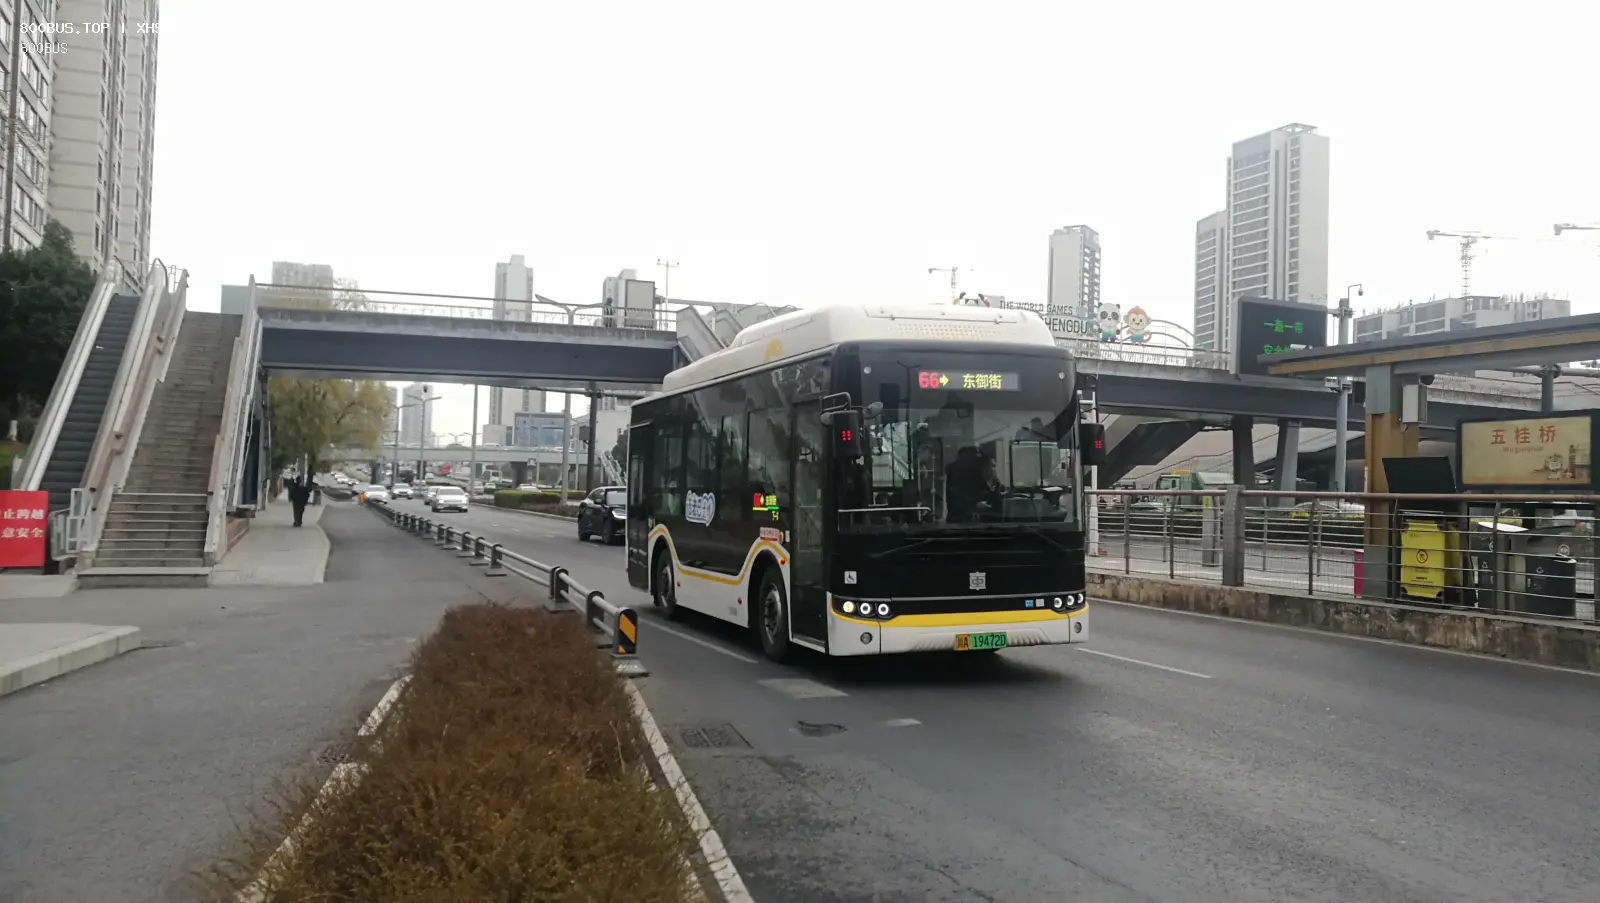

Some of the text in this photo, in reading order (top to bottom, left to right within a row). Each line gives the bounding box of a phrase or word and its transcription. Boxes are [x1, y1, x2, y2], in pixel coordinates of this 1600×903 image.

[999, 300, 1074, 316] THE WORLD GAMES
[1044, 316, 1089, 335] HENGDU
[918, 371, 940, 389] 66
[962, 373, 1002, 390] 东御街
[1490, 424, 1557, 446] 五桂桥
[0, 508, 45, 520] 止跨越
[1, 527, 45, 539] 意安全
